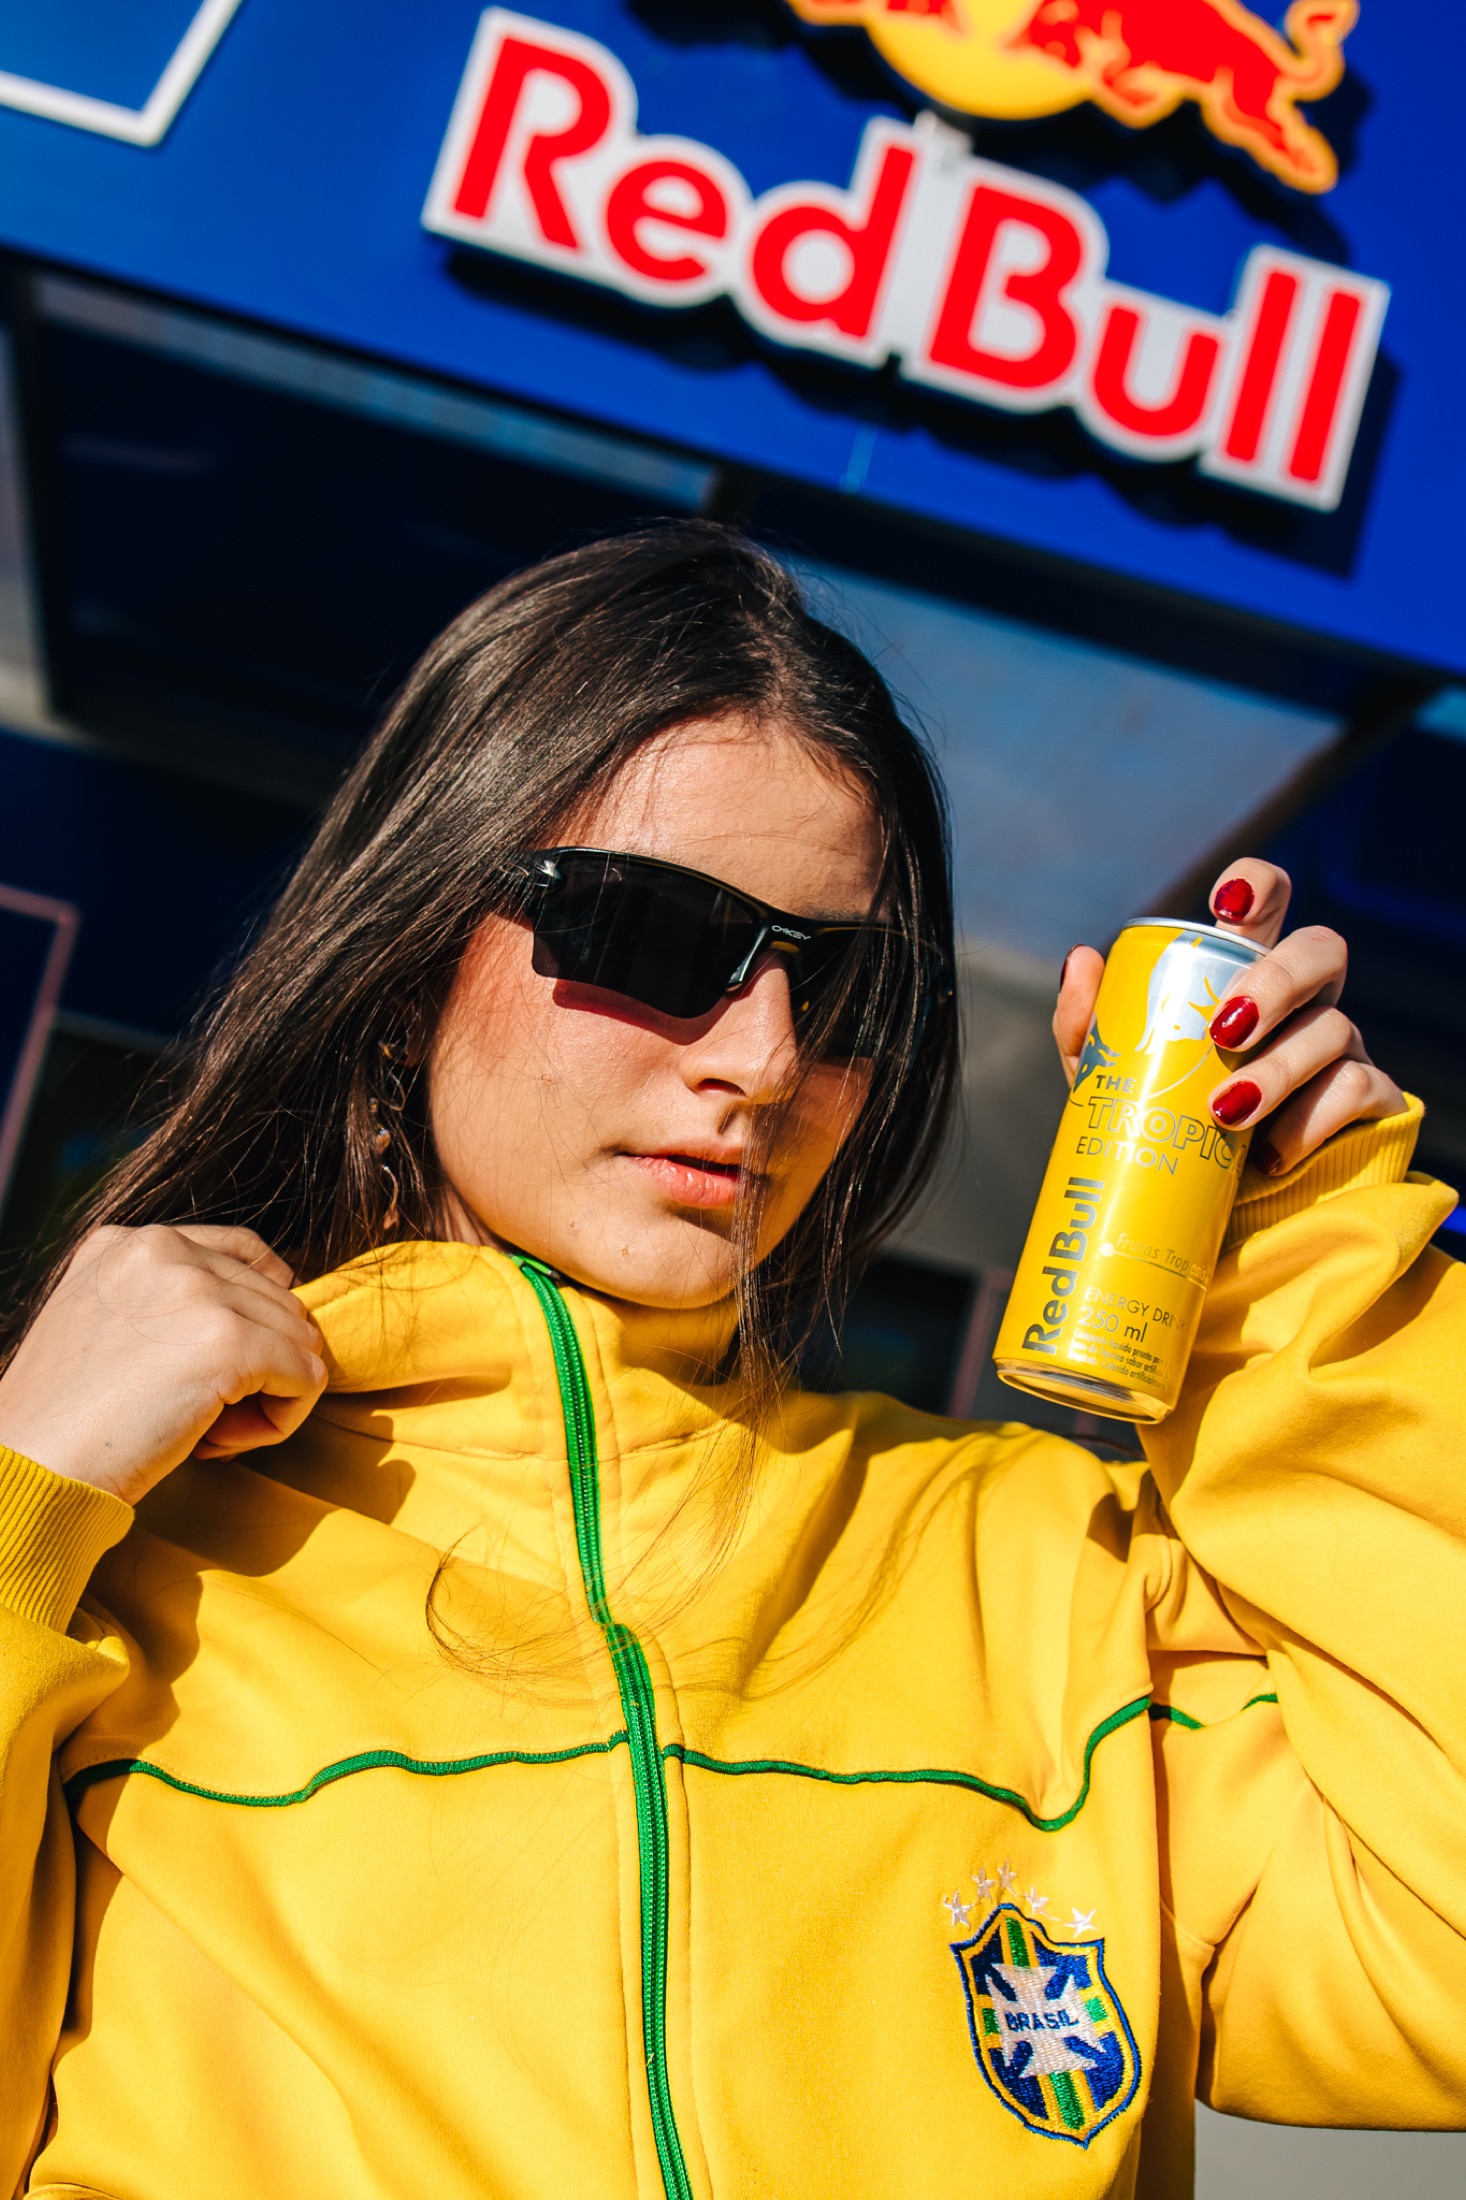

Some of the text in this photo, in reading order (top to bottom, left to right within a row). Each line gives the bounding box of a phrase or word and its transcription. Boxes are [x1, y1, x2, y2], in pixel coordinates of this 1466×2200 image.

[451, 33, 1364, 486] Red Bull
[1096, 1074, 1135, 1094] THE
[1076, 1135, 1178, 1175] EDITION
[1021, 1176, 1104, 1355] Red Bull
[1084, 1286, 1150, 1317] ENERGY
[1077, 1305, 1148, 1342] 250 ml
[1004, 2009, 1080, 2032] BRASIL
